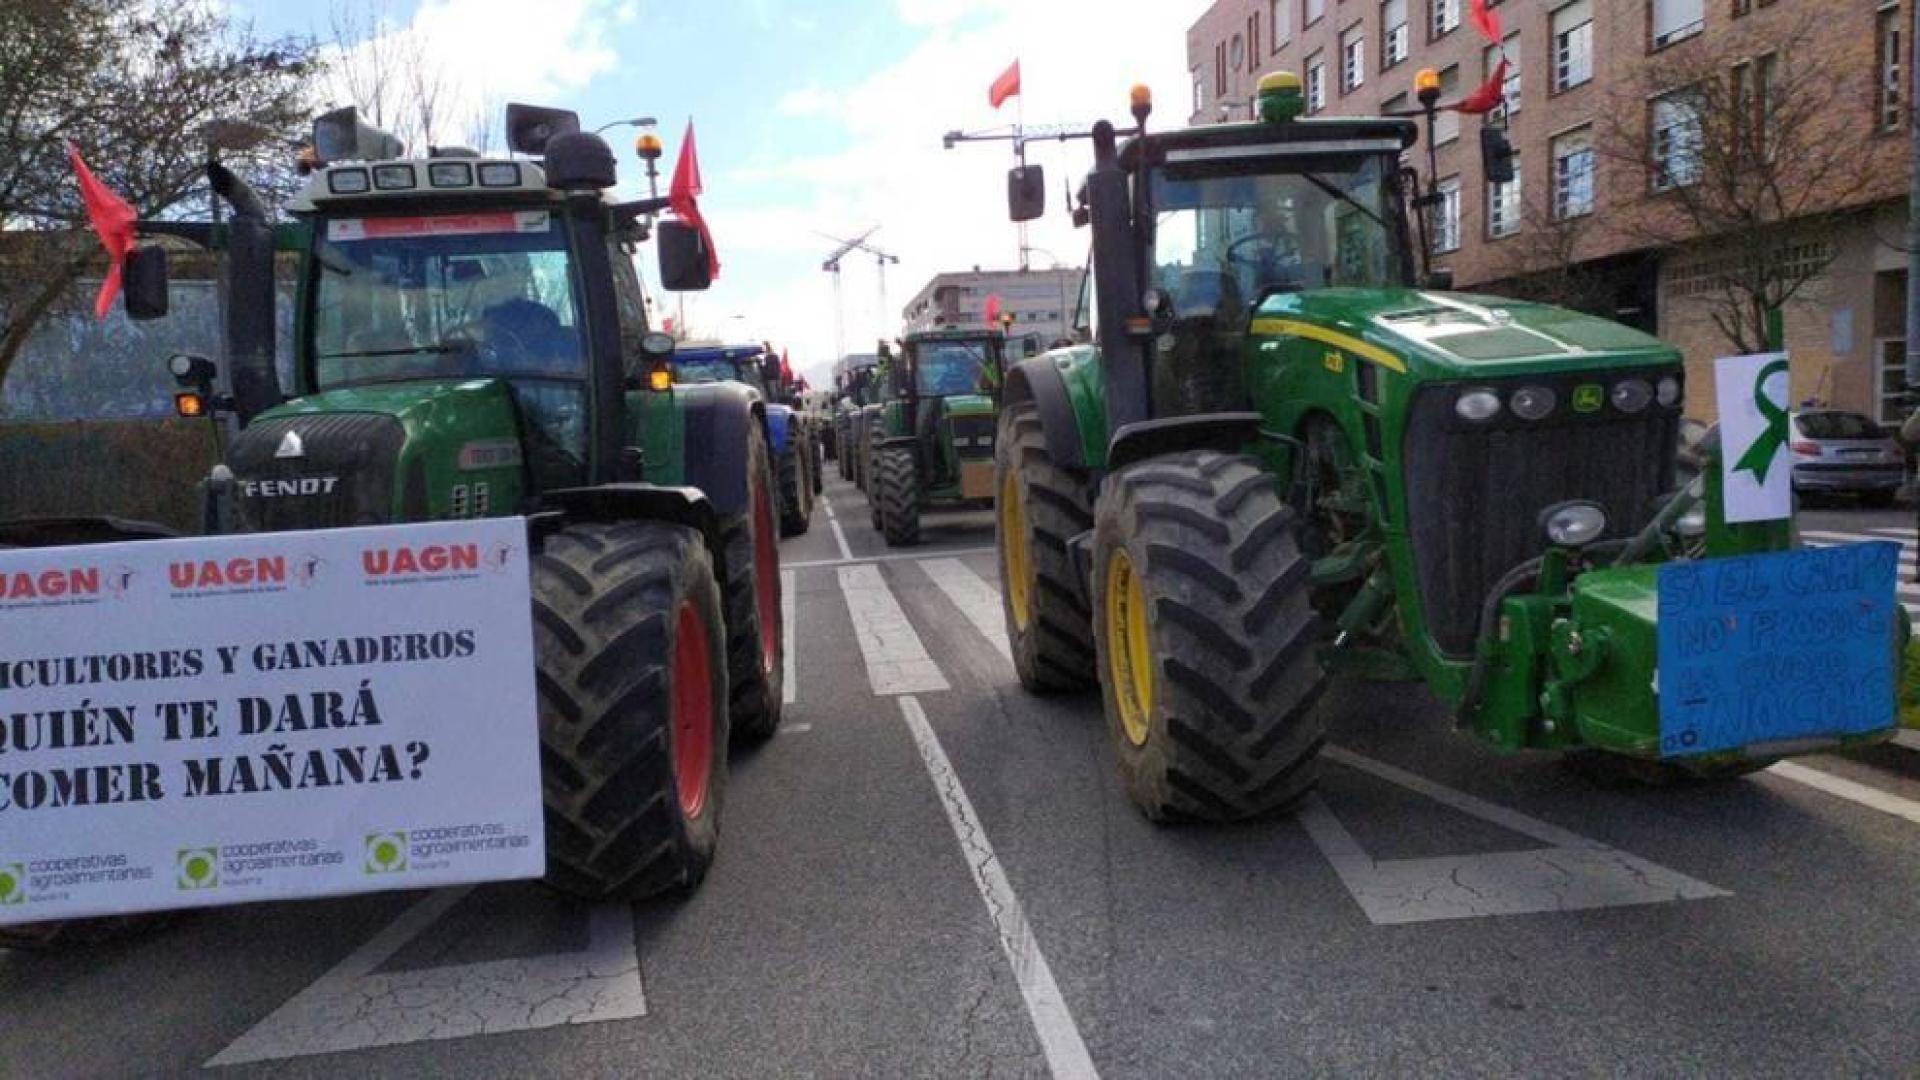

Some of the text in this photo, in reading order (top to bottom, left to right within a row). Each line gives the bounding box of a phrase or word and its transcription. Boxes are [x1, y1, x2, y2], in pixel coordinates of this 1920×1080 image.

[246, 477, 338, 497] FENDT
[169, 556, 286, 588] UAGN
[363, 543, 480, 575] UAGN
[0, 567, 99, 598] AGN
[217, 646, 240, 674] Y
[252, 629, 476, 672] GANADEROS
[0, 679, 382, 753] UIÉN TE DARÁ
[182, 741, 430, 798] MAÑANA?
